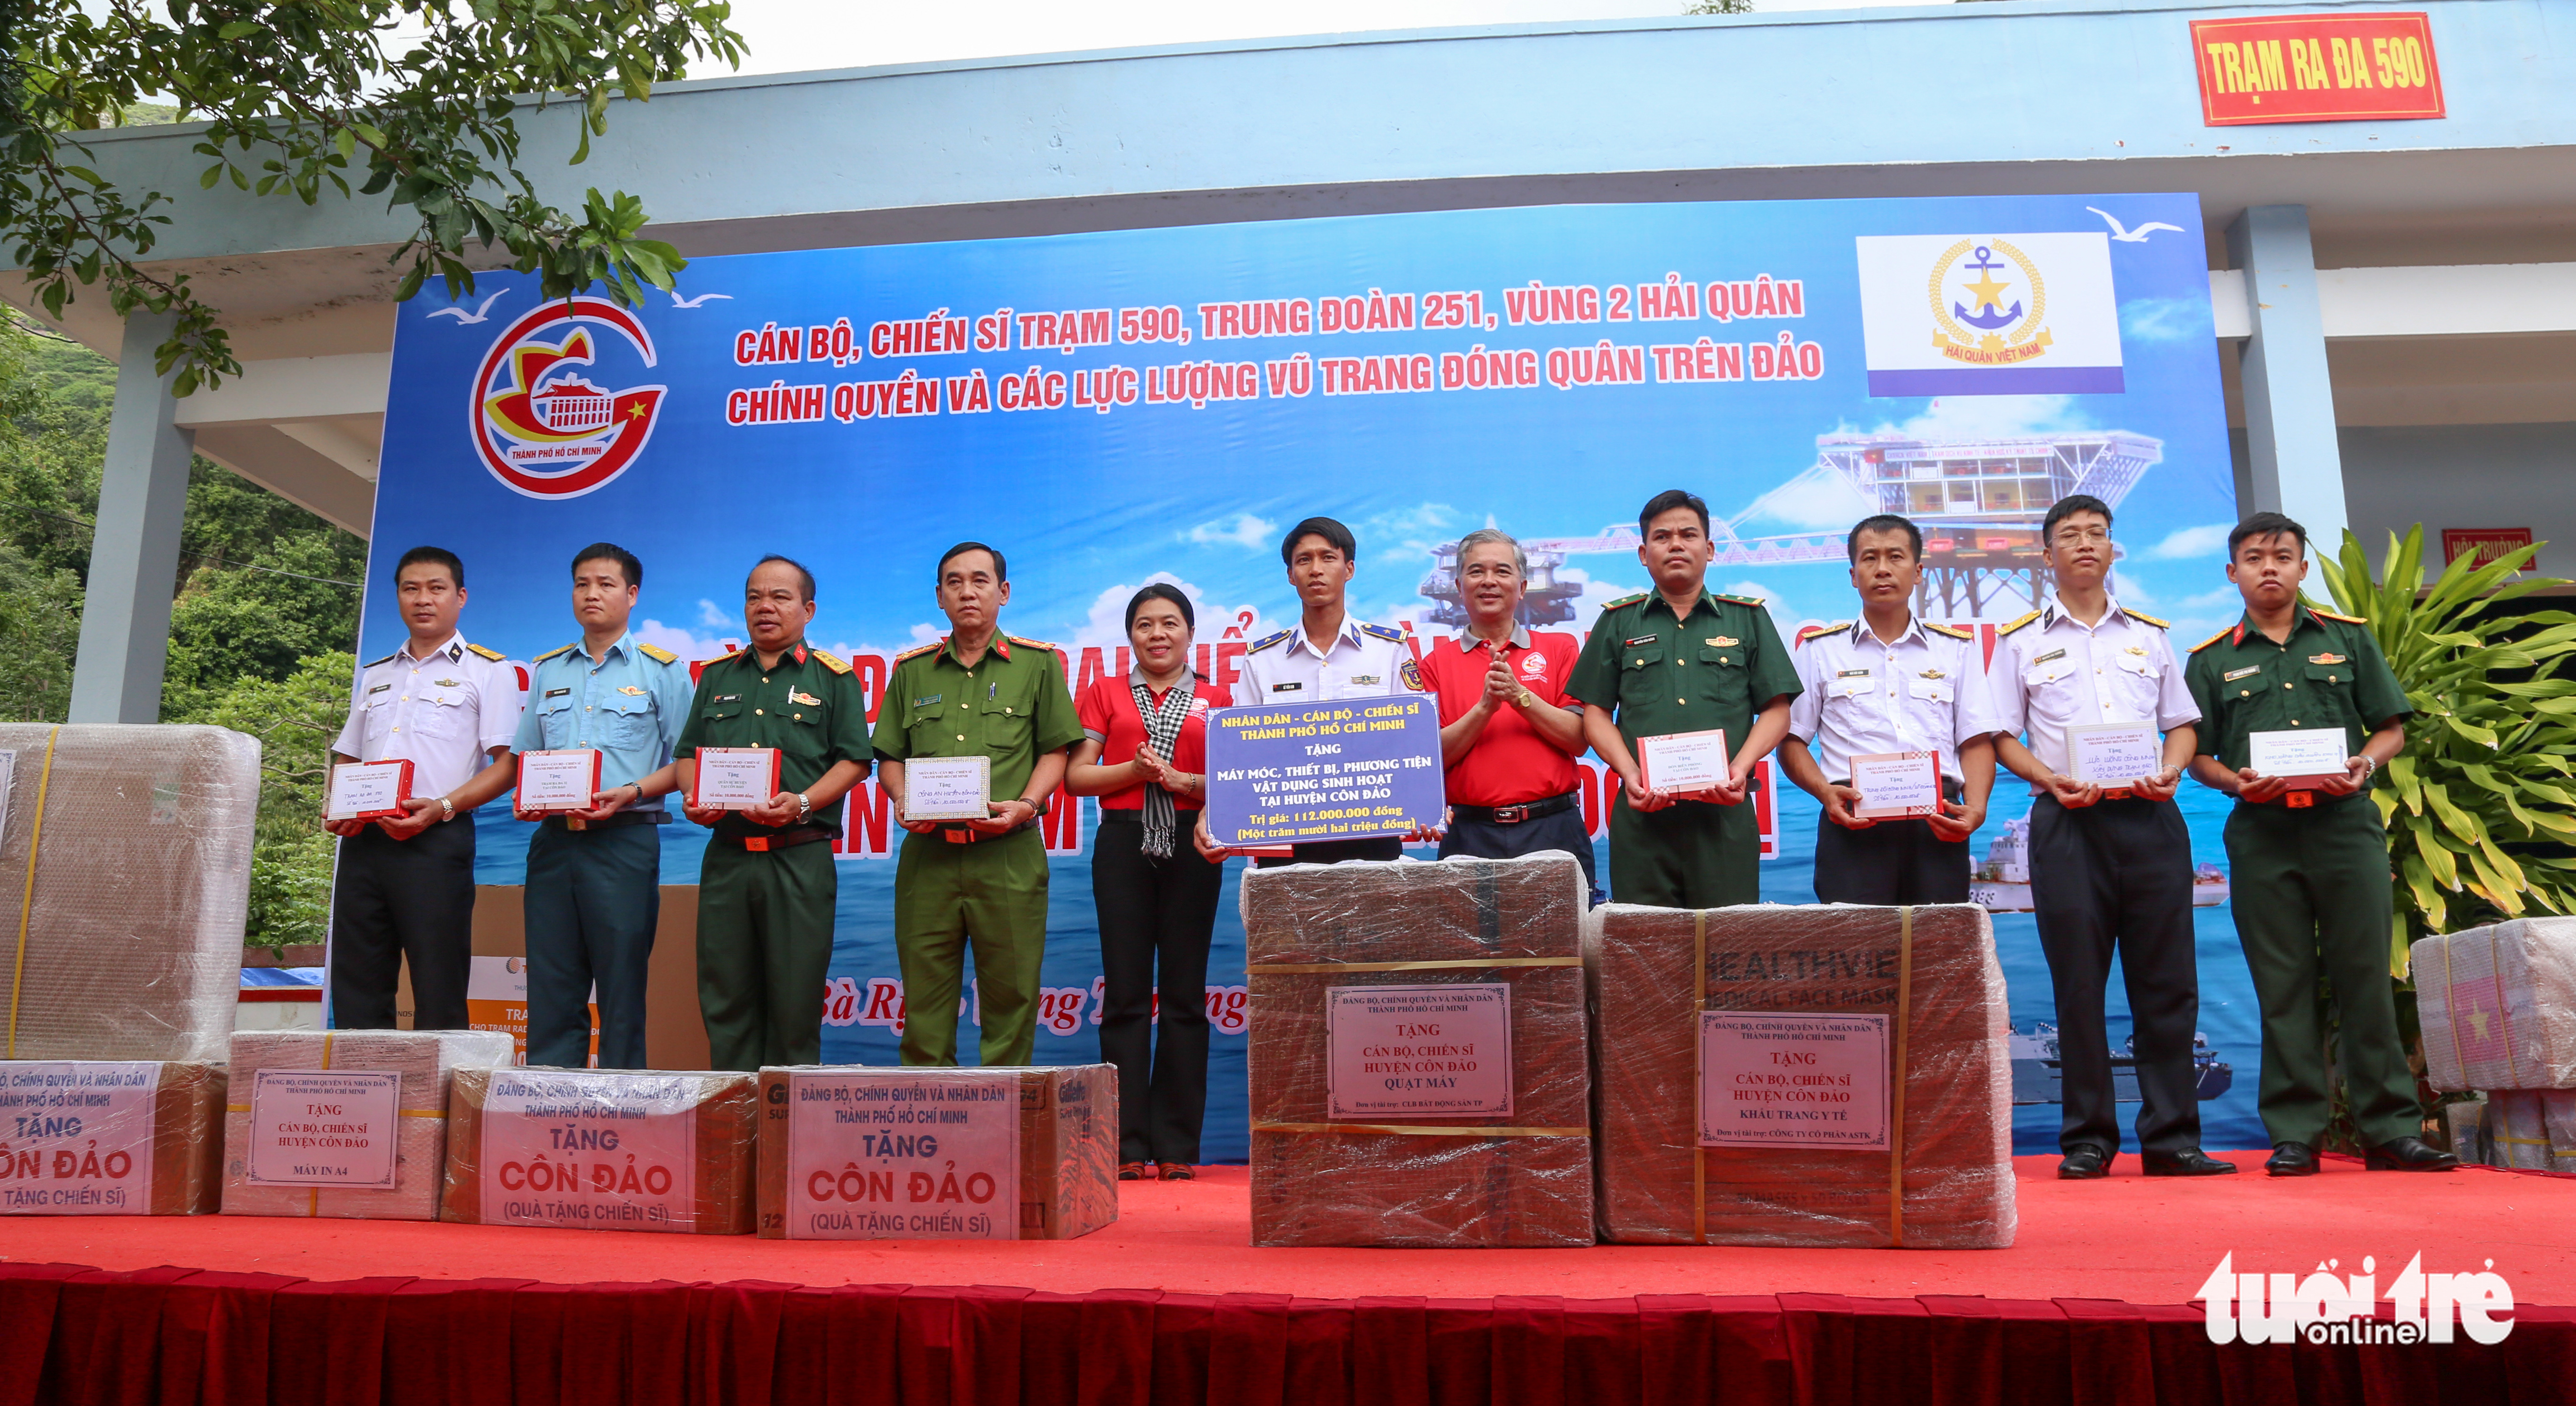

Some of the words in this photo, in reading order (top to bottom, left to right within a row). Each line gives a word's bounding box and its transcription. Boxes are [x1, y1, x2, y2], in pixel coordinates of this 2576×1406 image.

[2207, 40, 2288, 104] TRẠM
[2289, 39, 2331, 90] RA
[2331, 37, 2373, 89] ĐA
[2373, 36, 2426, 89] 590
[736, 323, 799, 363] CÁN
[810, 319, 860, 365] BỘ,
[871, 309, 966, 358] CHIẾN
[976, 309, 1013, 352] SĨ
[1017, 310, 1109, 356] TRẠM
[1119, 306, 1190, 345] 590,
[1200, 298, 1310, 337] TRUNG
[1321, 288, 1413, 333] ĐOÀN
[1424, 293, 1497, 331] 251,
[1506, 282, 1598, 326] VÙNG
[1609, 287, 1632, 321] 2
[1640, 272, 1697, 320] HẢI
[1707, 274, 1802, 322] QUÂN
[1946, 345, 1962, 358] HẢI
[1965, 350, 1992, 362] QUÂN
[1996, 349, 2016, 363] VIỆT
[2020, 343, 2041, 358] NAM
[728, 381, 824, 425] CHÍNH
[835, 370, 937, 423] QUYỀN
[949, 371, 989, 415] VÀ
[1000, 367, 1064, 411] CÁC
[1075, 367, 1136, 414] LỰC
[1146, 361, 1258, 408] LƯỢNG
[1267, 353, 1312, 397] VŨ
[1323, 356, 1431, 395] TRANG
[1442, 346, 1536, 390] ĐÓNG
[1548, 340, 1643, 388] QUÂN
[1652, 337, 1741, 381] TRÊN
[1751, 332, 1823, 378] ĐẢO
[512, 448, 536, 459] THÀNH
[538, 447, 554, 457] PHỐ
[555, 446, 565, 457] HỒ
[567, 446, 580, 456] CHÍ
[582, 447, 601, 455] MINH
[1222, 714, 1259, 728] NHÂN
[1263, 713, 1291, 725] DÂN
[1302, 711, 1330, 722] CÁN
[1334, 708, 1353, 721] BỘ
[1364, 703, 1403, 718] CHIẾN
[1407, 703, 1419, 714] SĨ
[1240, 728, 1285, 740] THÀNH
[1289, 724, 1317, 737] PHỐ
[1320, 722, 1339, 735] HỒ
[1344, 721, 1366, 733] CHÍ
[1370, 719, 1405, 731] MINH
[1305, 744, 1341, 756] TẶNG
[1217, 768, 1245, 781] MÁY
[1248, 766, 1282, 779] MÓC,
[1285, 762, 1320, 777] THIẾT
[1324, 765, 1340, 775] BỊ,
[1343, 759, 1400, 772] PHƯƠNG
[1402, 756, 1431, 770] TIỆN
[1252, 781, 1278, 794] VẬT
[1281, 779, 1318, 792] DỤNG
[1322, 777, 1353, 788] SINH
[1357, 773, 1393, 787] HOẠT
[1259, 796, 1280, 808] TẠI
[1284, 792, 1326, 806] HUYỆN
[1330, 789, 1360, 802] CÔN
[1363, 786, 1391, 799] ĐẢO
[1249, 814, 1265, 825] Trị
[1268, 813, 1289, 825] giá:
[1294, 807, 1370, 822] 112.000.000
[1373, 805, 1403, 817] đồng
[1237, 828, 1265, 841] (Một
[1268, 825, 1295, 837] trăm
[1299, 823, 1327, 835] mười
[1331, 822, 1349, 833] hai
[1351, 820, 1378, 831] triệu
[1382, 817, 1416, 830] đồng)
[506, 1009, 528, 1020] TRA
[1396, 1022, 1440, 1039] TẶNG
[802, 1084, 831, 1101] ĐẢNG
[835, 1084, 852, 1105] BỘ,
[855, 1084, 888, 1101] CHÍNH
[892, 1082, 926, 1102] QUYỀN
[929, 1084, 945, 1101] VÀ
[948, 1084, 978, 1101] NHÂN
[981, 1084, 1005, 1101] DÂN
[1385, 1078, 1422, 1091] QUẠT
[1426, 1076, 1457, 1088] MÁY
[307, 1103, 342, 1117] TẶNG
[1740, 1108, 1774, 1119] KHẨU
[1777, 1110, 1819, 1120] TRANG
[1821, 1111, 1830, 1120] Y
[1833, 1109, 1847, 1120] TẾ
[16, 1112, 82, 1143] TẶNG
[279, 1136, 316, 1149] HUYỆN
[319, 1136, 342, 1147] CÔN
[345, 1136, 368, 1148] ĐẢO
[550, 1124, 619, 1156] TẶNG
[863, 1129, 937, 1164] TẶNG
[0, 1143, 41, 1179] ÔN
[52, 1140, 132, 1179] ĐẢO
[294, 1164, 319, 1175] MÁY
[321, 1166, 333, 1175] IN
[335, 1167, 347, 1176] A4
[499, 1153, 578, 1192] CÔN
[591, 1153, 672, 1195] ĐẢO
[808, 1162, 893, 1202] CÔN
[907, 1160, 996, 1204] ĐẢO
[811, 1211, 853, 1233] (QUÀ
[857, 1211, 904, 1235] TẶNG
[910, 1210, 963, 1232] CHIẾN
[969, 1212, 991, 1237] SĨ)
